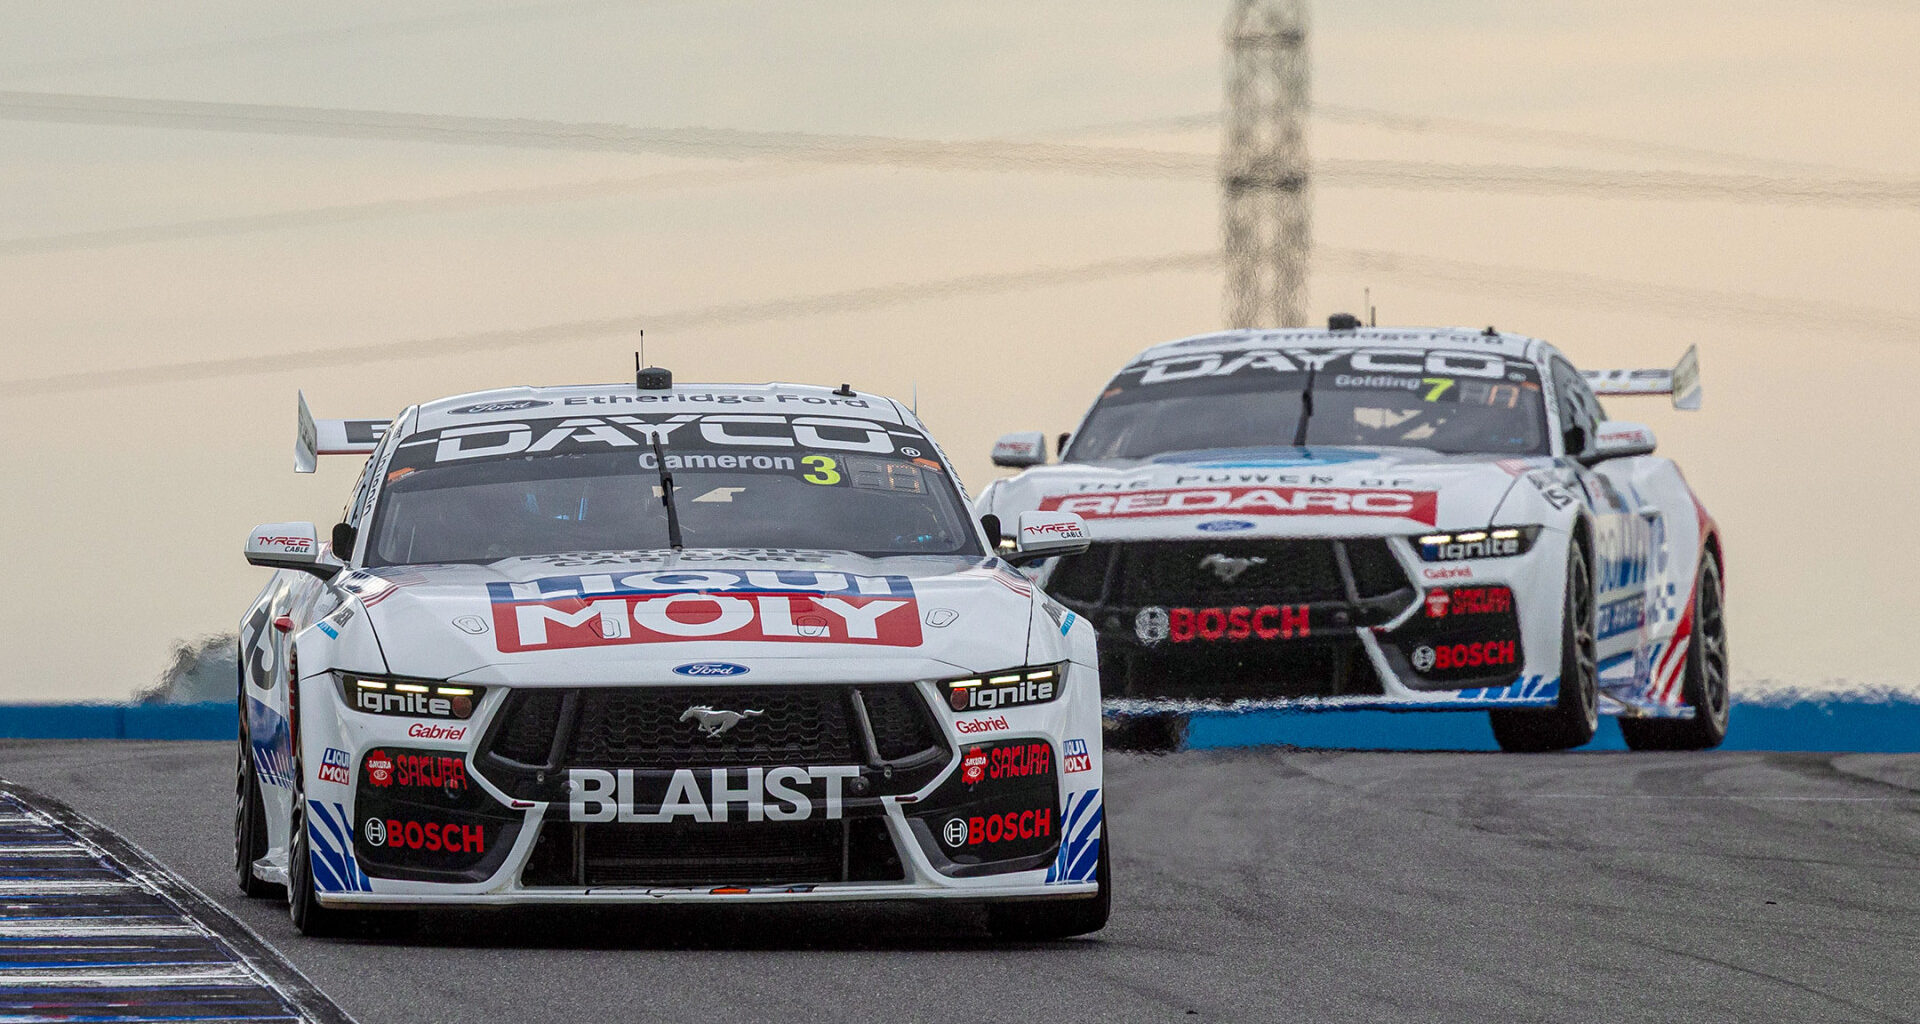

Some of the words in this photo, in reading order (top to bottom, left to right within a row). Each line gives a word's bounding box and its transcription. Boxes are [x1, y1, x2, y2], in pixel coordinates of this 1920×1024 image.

[1139, 350, 1505, 384] DAYCO
[1335, 374, 1422, 390] Golding
[1422, 378, 1455, 402] 7
[468, 401, 530, 413] Ford
[565, 393, 764, 405] Etheridge
[776, 394, 869, 409] Ford
[435, 414, 895, 463] DAYCO
[638, 452, 795, 470] Cameron
[801, 455, 841, 485] 3
[1176, 474, 1333, 484] POWER
[1057, 490, 1413, 513] REDARC
[258, 536, 313, 546] TYREE
[1024, 522, 1080, 535] TYREE
[1061, 531, 1083, 539] CABLE
[1438, 539, 1519, 560] ignite
[510, 571, 892, 600] LIQUI
[515, 593, 910, 646] MOLY
[1169, 604, 1311, 642] BOSCH
[1435, 640, 1515, 669] BOSCH
[688, 664, 733, 675] Ford
[357, 688, 451, 715] ignite
[970, 682, 1053, 708] ignite
[408, 723, 467, 740] Gabriel
[956, 715, 1009, 734] Gabriel
[324, 749, 350, 768] LIQUI
[397, 754, 468, 790] SAKURA
[990, 743, 1049, 779] SAKURA
[321, 764, 349, 784] MOLY
[569, 766, 860, 823] BLAHST
[386, 819, 484, 853] BOSCH
[968, 808, 1051, 845] BOSCH
